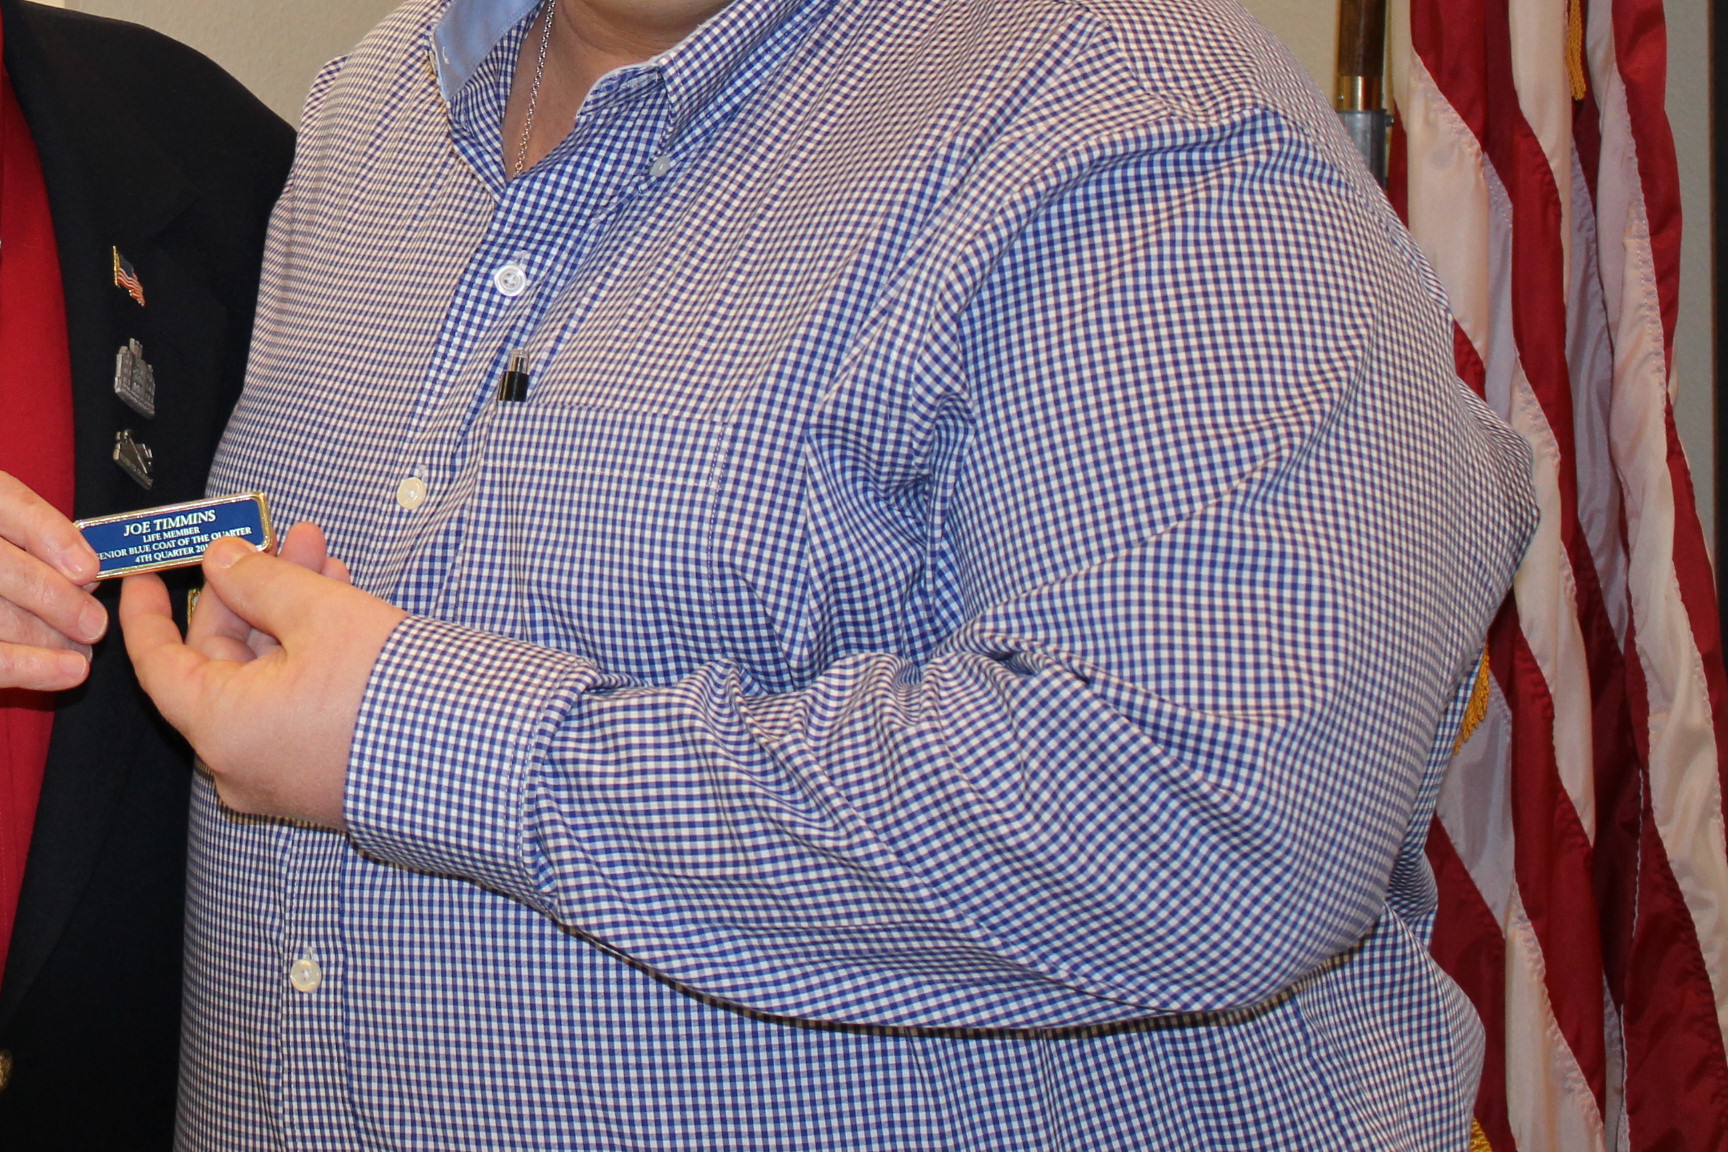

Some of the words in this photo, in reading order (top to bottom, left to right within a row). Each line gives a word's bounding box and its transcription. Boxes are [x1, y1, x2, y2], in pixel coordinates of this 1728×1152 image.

[123, 521, 151, 536] JOE
[153, 510, 216, 531] TIMMINS
[142, 534, 161, 543] LIFE
[163, 526, 200, 540] MEMBER
[96, 550, 127, 560] ENIOR
[129, 544, 151, 555] BLUE
[152, 539, 176, 551] COAT
[178, 537, 190, 547] OF
[192, 533, 210, 544] THE
[135, 553, 153, 563] 4TH
[154, 547, 194, 561] QUARTER
